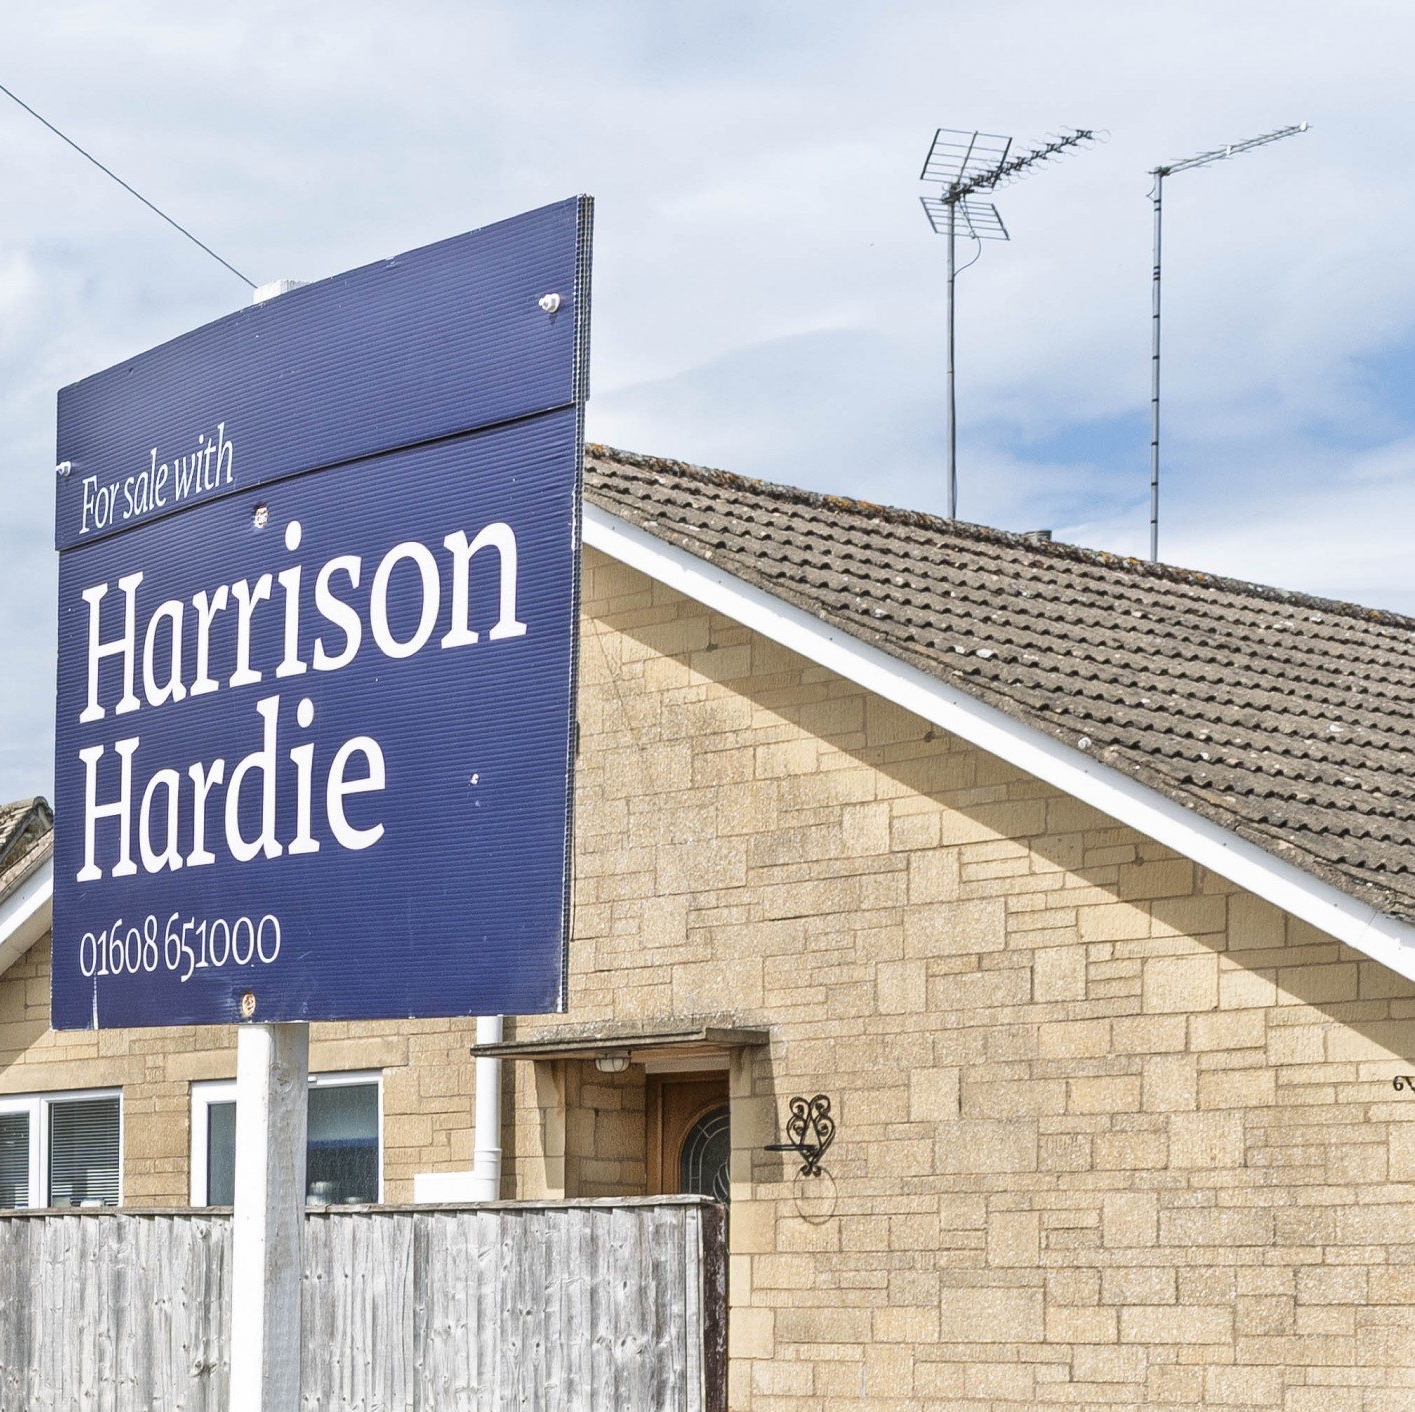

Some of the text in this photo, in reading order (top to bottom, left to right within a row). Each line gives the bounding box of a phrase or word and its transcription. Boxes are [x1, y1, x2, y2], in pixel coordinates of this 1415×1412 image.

[79, 421, 234, 534] For sale with
[79, 520, 528, 724] Harrison
[76, 695, 386, 882] Hardie
[79, 911, 281, 983] 01608 651000
